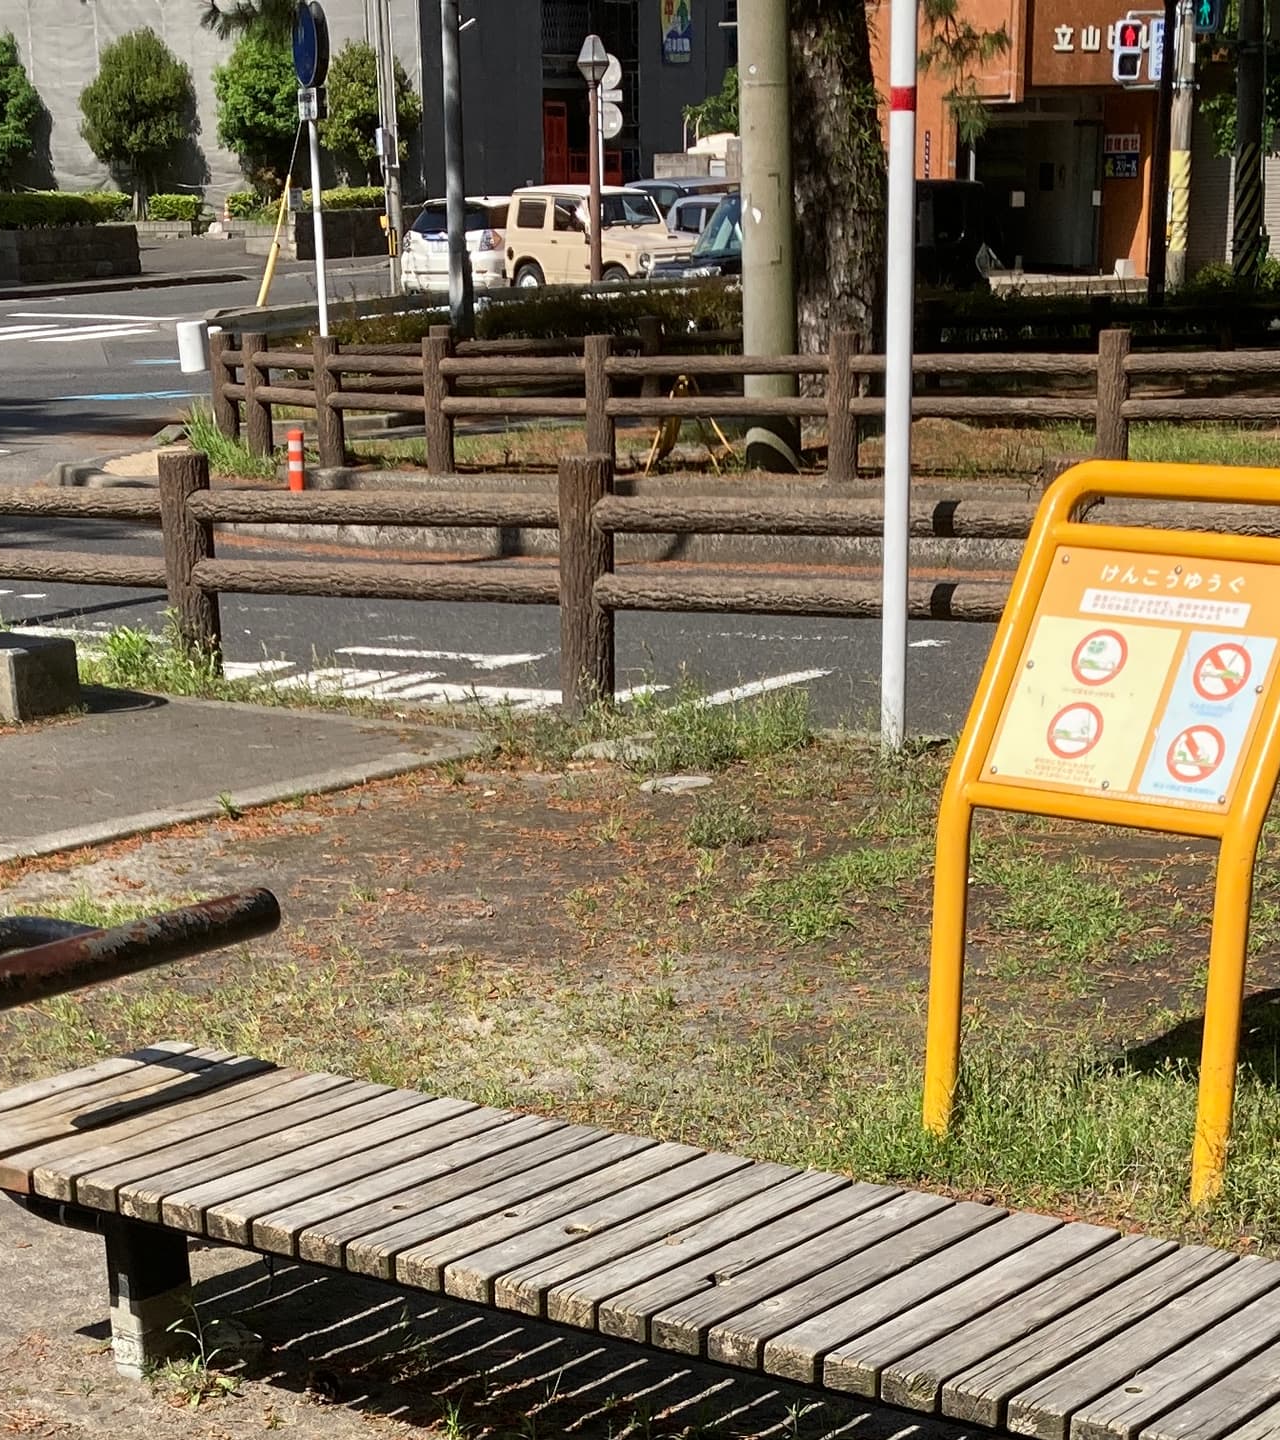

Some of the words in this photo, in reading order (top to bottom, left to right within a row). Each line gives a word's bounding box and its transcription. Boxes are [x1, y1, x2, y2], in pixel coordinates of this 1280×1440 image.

[1100, 564, 1246, 594] けんこうゆうぐ
